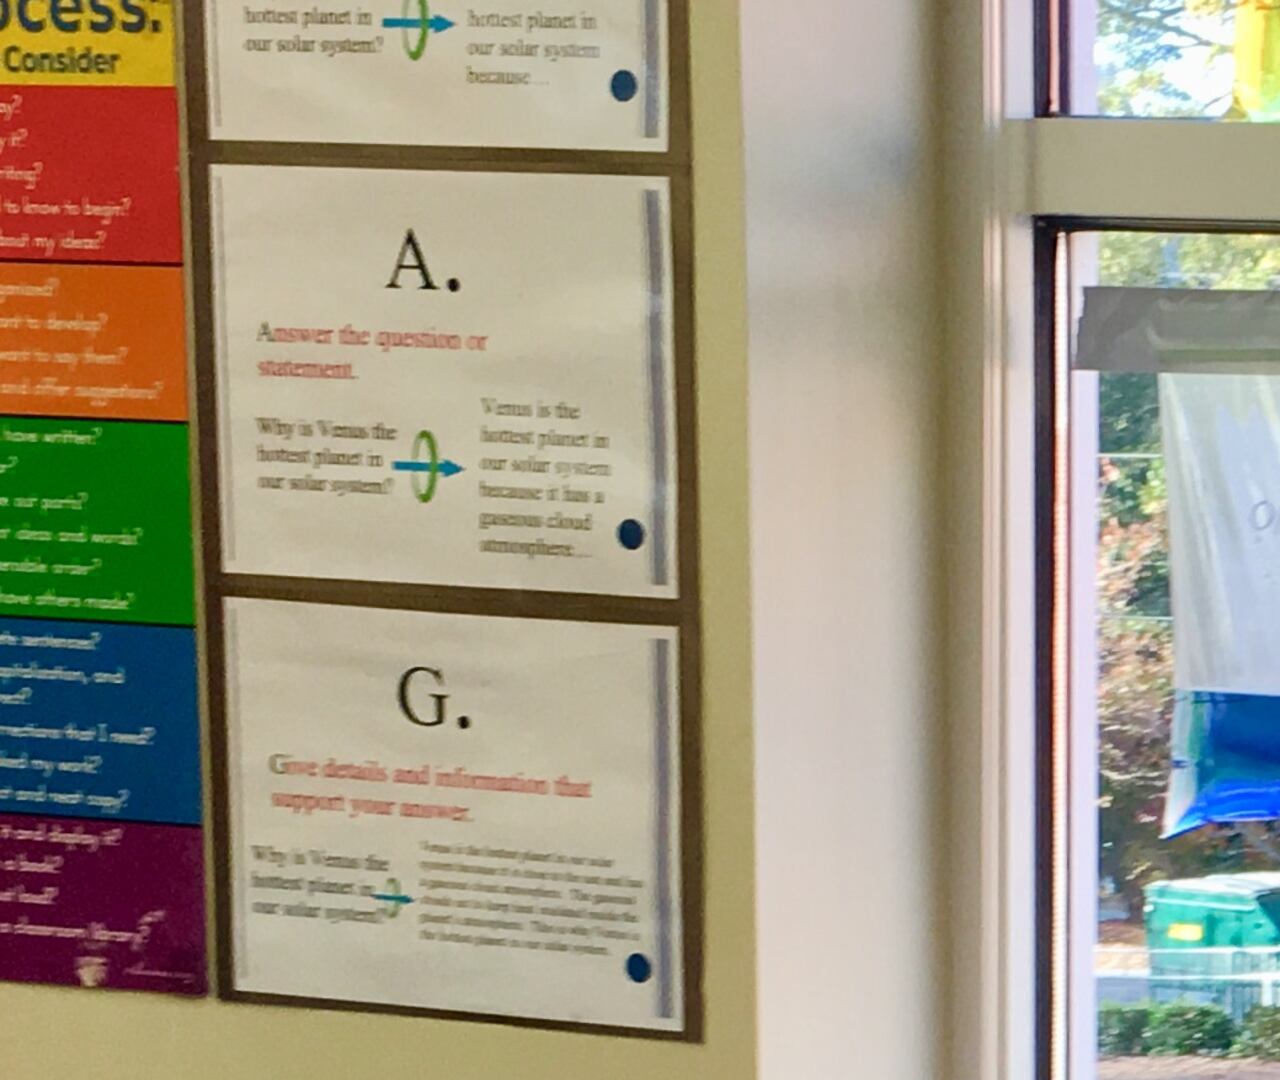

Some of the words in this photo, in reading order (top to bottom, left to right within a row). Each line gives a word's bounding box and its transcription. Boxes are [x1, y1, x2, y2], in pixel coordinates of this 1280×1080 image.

[303, 6, 352, 29] planet
[468, 9, 523, 28] hottest
[527, 11, 577, 33] planet
[277, 34, 316, 53] solar
[499, 39, 540, 57] solar
[543, 43, 601, 63] system
[4, 45, 121, 74] Consider
[384, 228, 462, 292] A.
[256, 321, 334, 344] Answer
[339, 324, 370, 346] the
[376, 326, 462, 352] question
[256, 417, 295, 441] Why
[397, 666, 471, 730] G.
